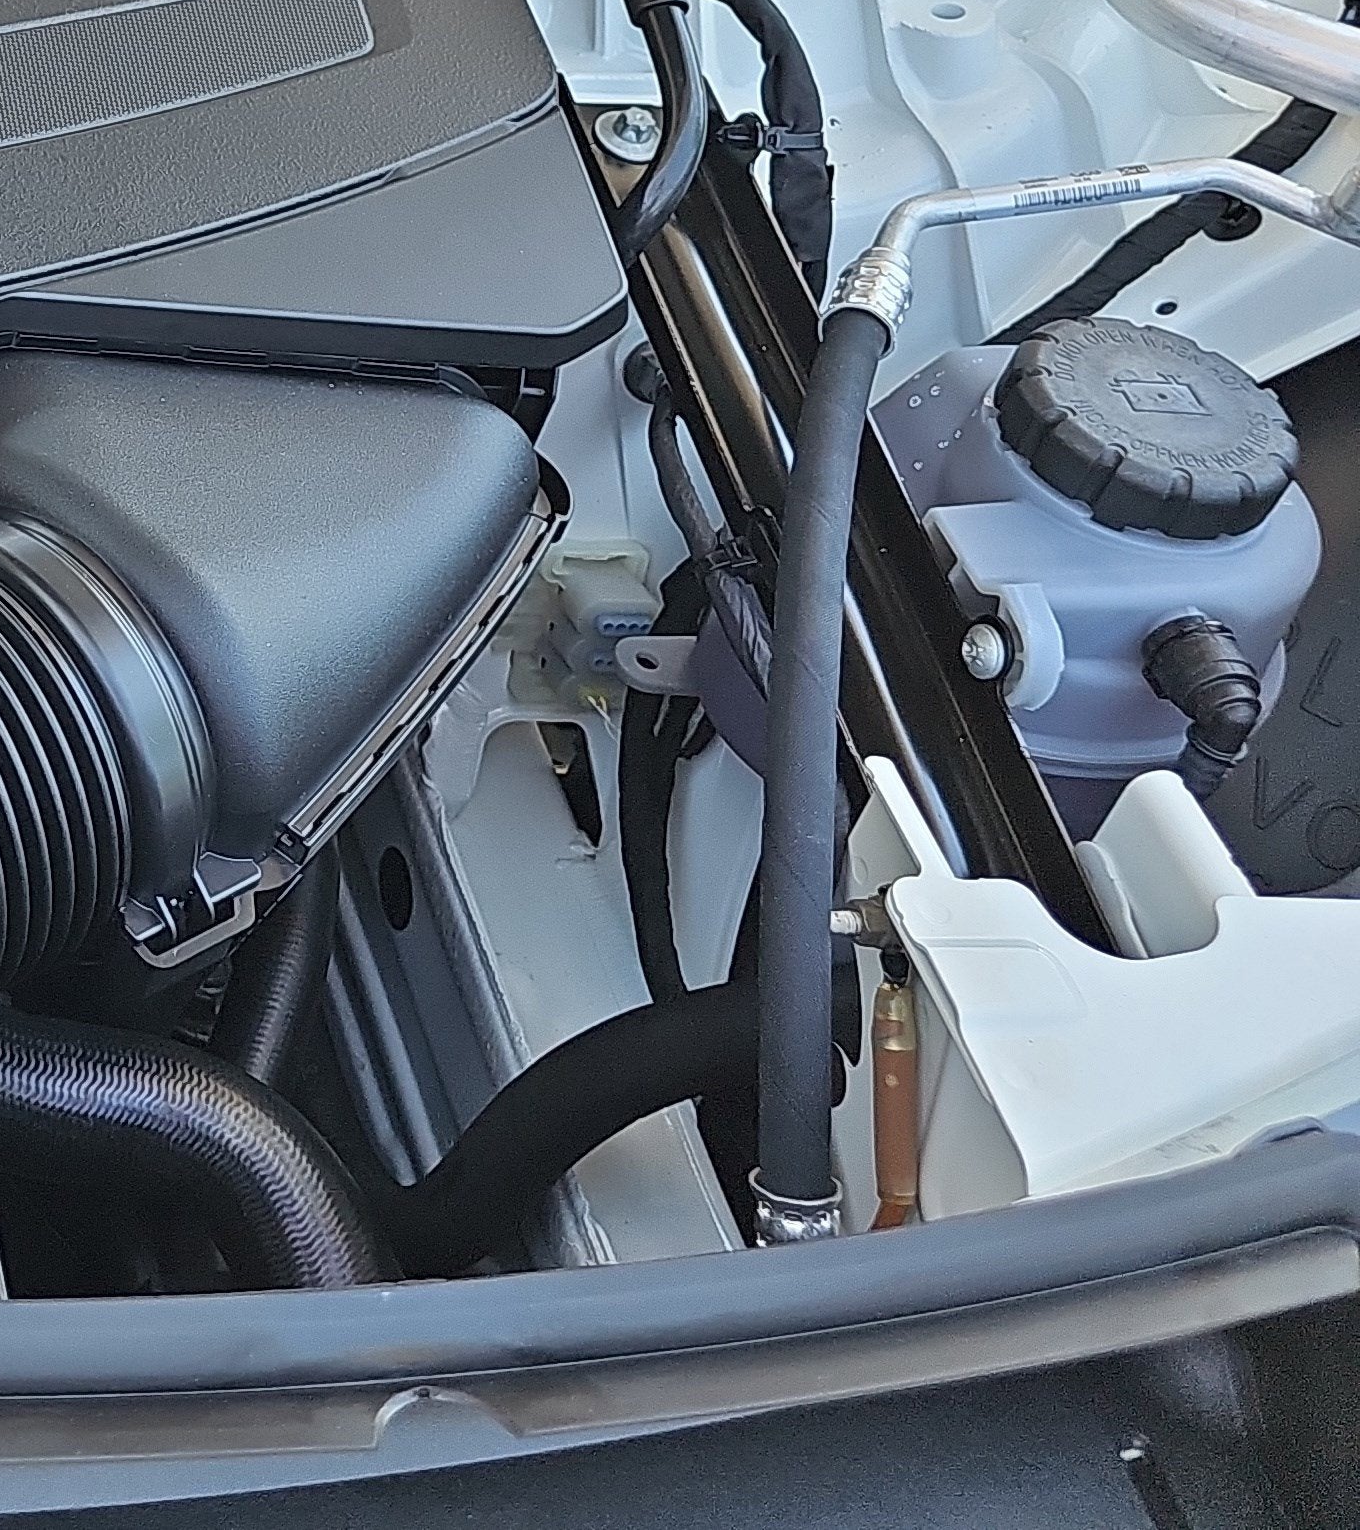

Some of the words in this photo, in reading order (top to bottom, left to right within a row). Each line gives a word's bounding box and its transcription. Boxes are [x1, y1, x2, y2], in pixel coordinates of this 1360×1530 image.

[1054, 359, 1076, 382] DO
[1082, 328, 1134, 346] OPEN
[1139, 332, 1201, 366] WHEN
